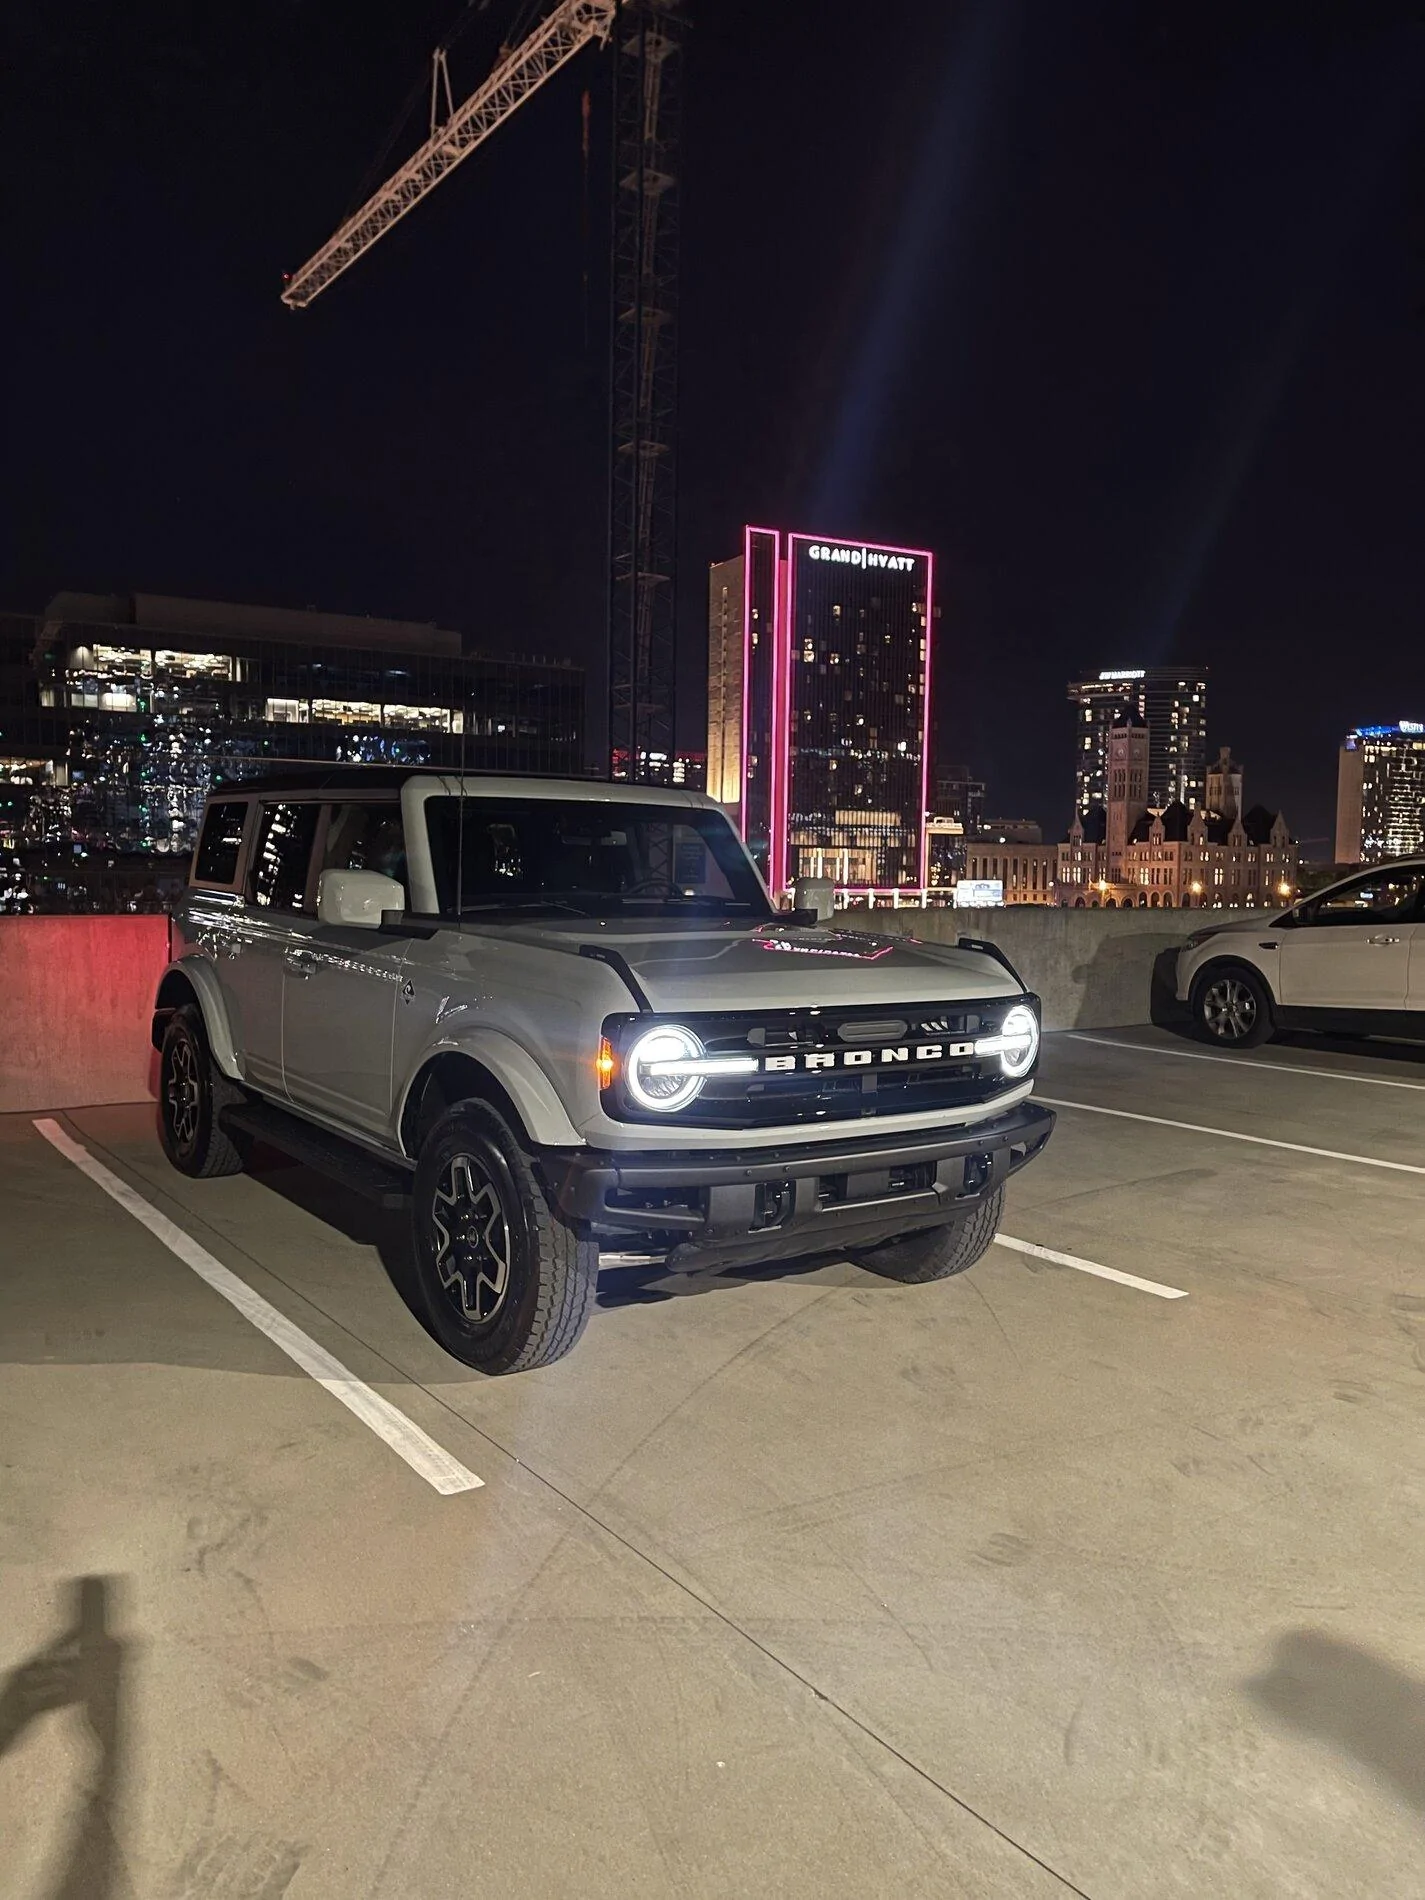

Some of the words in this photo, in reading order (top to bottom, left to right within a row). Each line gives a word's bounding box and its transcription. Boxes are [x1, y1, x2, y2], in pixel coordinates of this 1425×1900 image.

[808, 545, 861, 565] GRAND
[867, 552, 915, 572] HYATT
[765, 1042, 975, 1072] BRONCO
